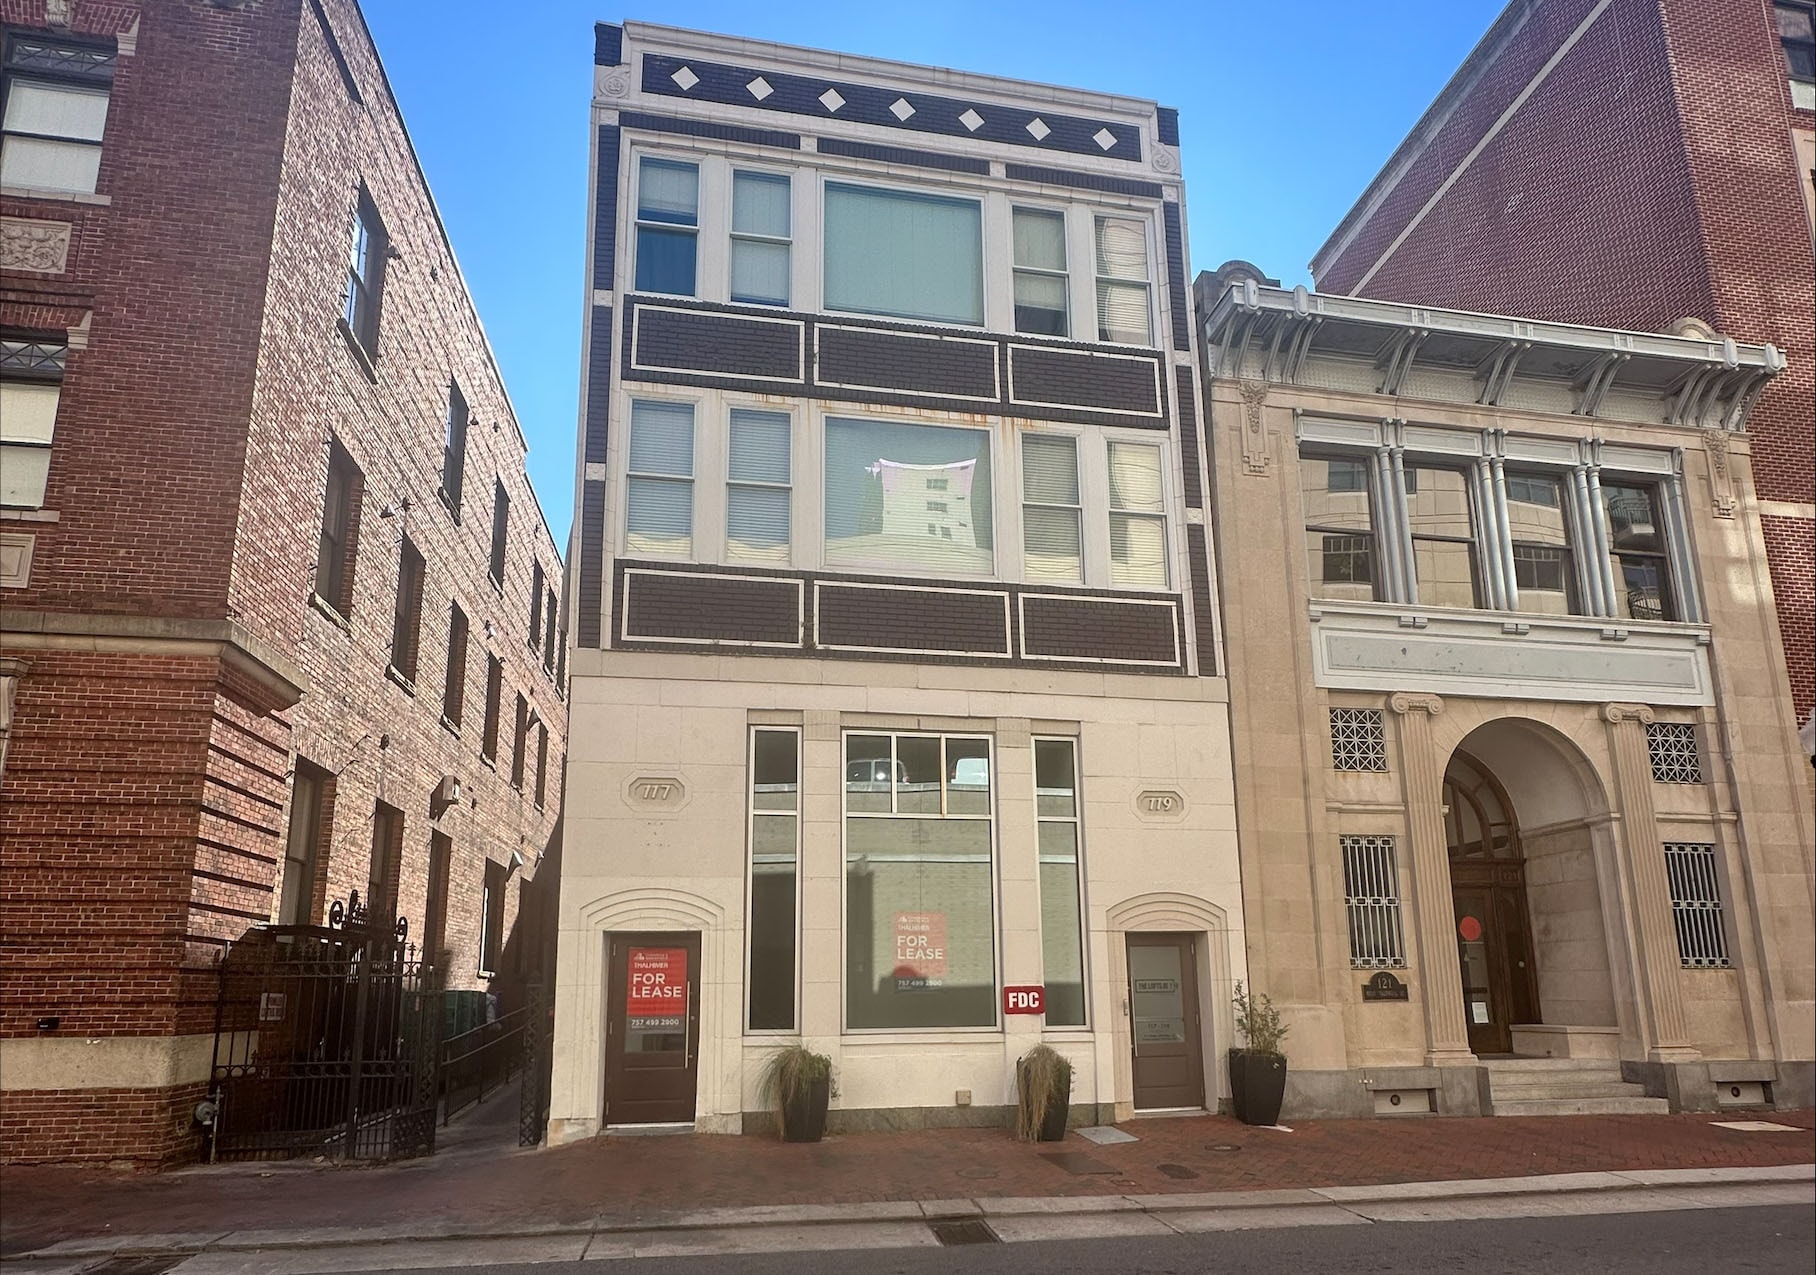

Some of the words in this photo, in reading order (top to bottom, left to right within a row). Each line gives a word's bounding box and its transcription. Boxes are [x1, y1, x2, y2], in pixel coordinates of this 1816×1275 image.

[643, 785, 670, 799] 117
[1149, 797, 1172, 811] 119
[897, 936, 927, 946] FOR
[897, 948, 943, 959] LEASE
[633, 973, 665, 985] FOR
[1378, 978, 1392, 989] 121
[632, 986, 682, 998] LEASE
[1008, 992, 1039, 1008] FDC
